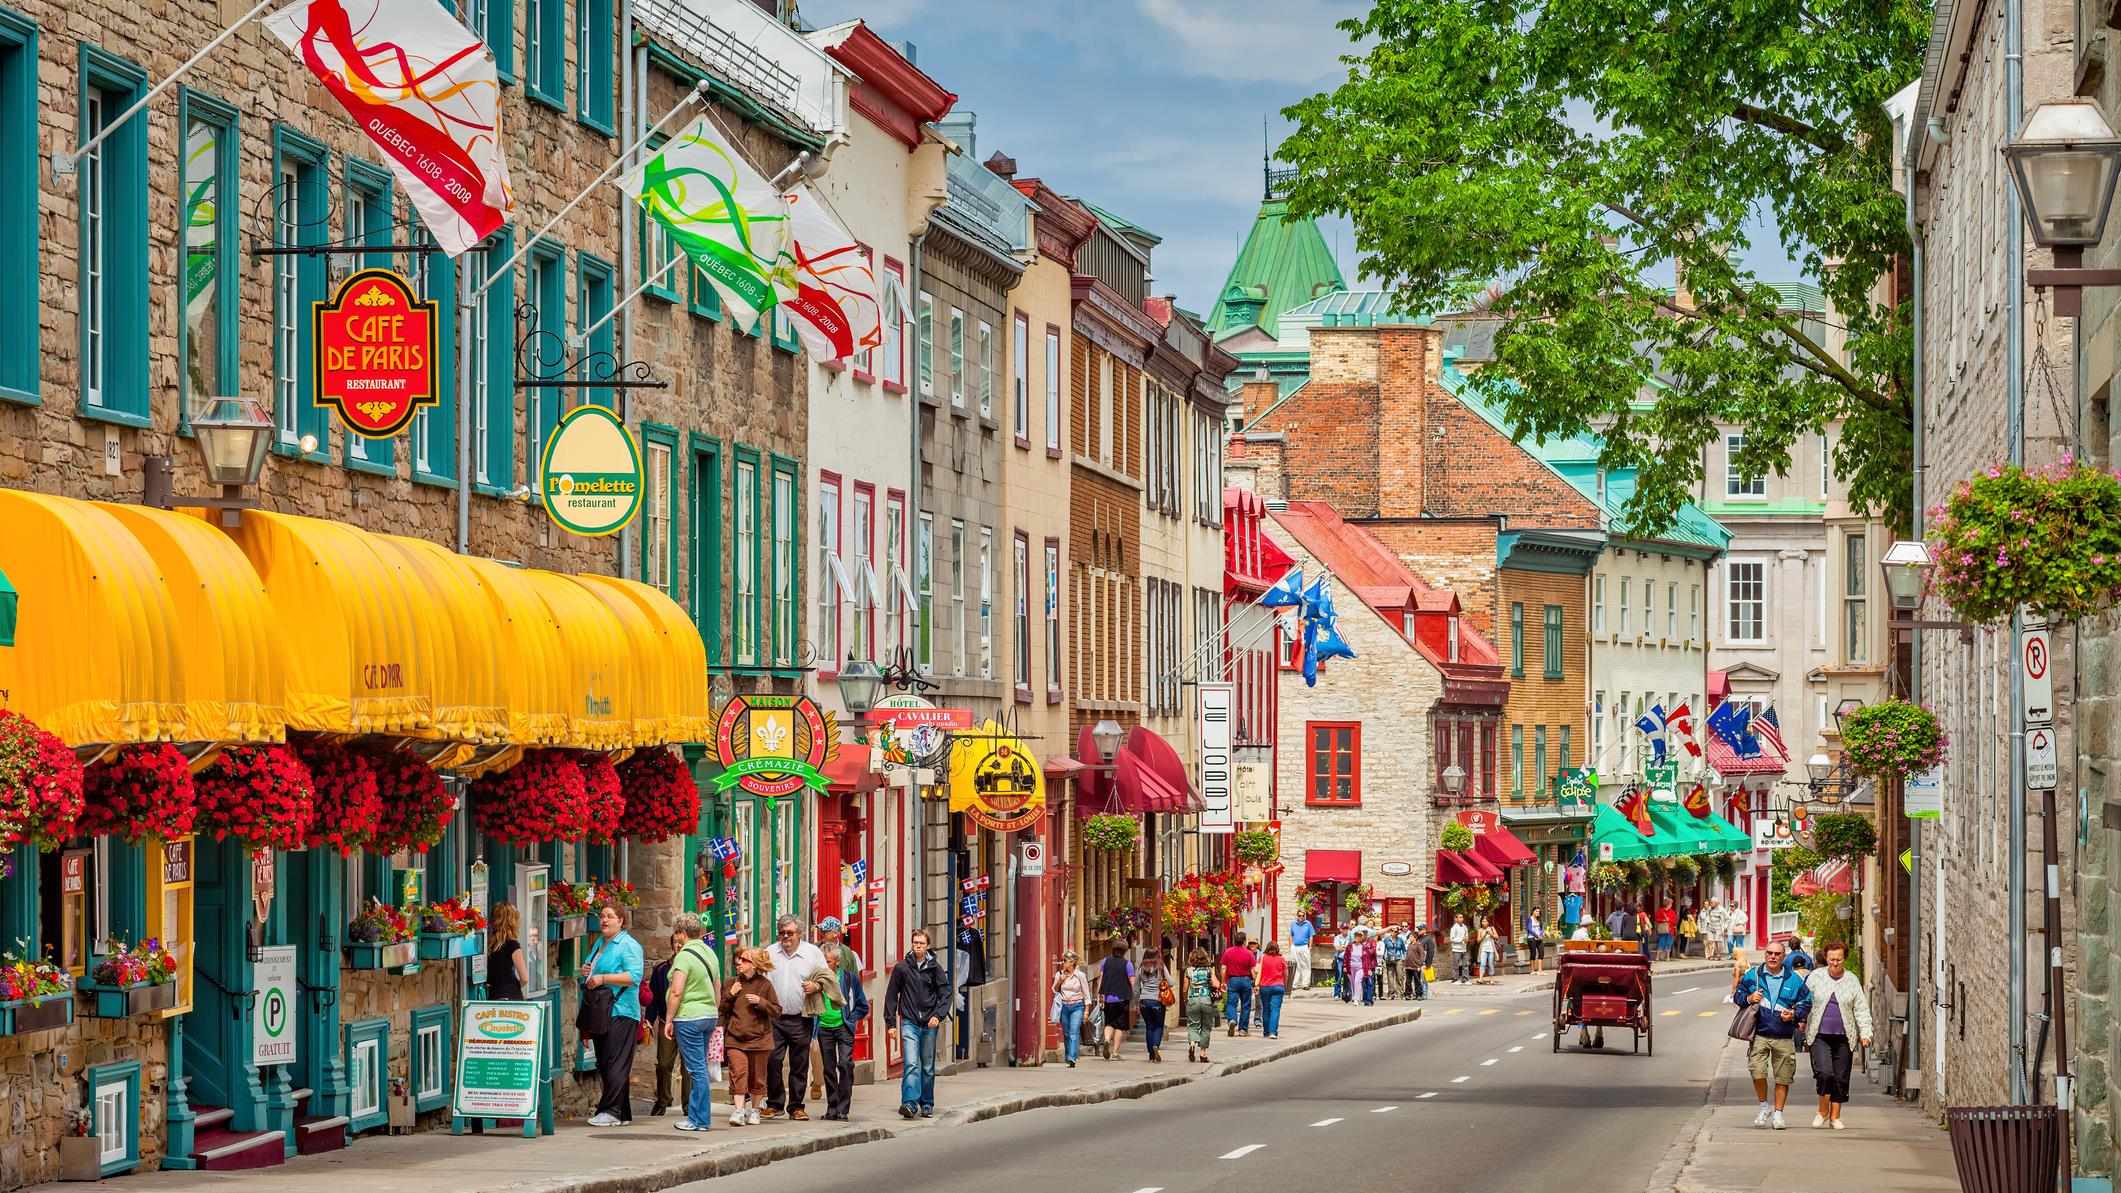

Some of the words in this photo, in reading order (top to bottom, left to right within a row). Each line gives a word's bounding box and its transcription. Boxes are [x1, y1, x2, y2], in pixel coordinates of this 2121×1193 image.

[368, 118, 417, 158] QUÉBEC
[700, 254, 736, 280] QUÉBEC
[345, 313, 405, 343] CAFÉ
[328, 345, 357, 371] DE
[361, 344, 424, 371] PARIS
[346, 379, 406, 390] RESTAURANT
[106, 442, 119, 460] 1827
[568, 498, 616, 508] restaurant
[751, 697, 792, 707] MAISON
[890, 698, 920, 708] HÔTEL
[898, 712, 951, 721] CAVALIER
[1204, 701, 1227, 722] LE
[936, 720, 958, 728] moulin
[737, 759, 804, 772] CRÉMAZIE
[1203, 739, 1228, 815] LOBBY
[747, 781, 795, 792] SOUVENIRS
[970, 807, 979, 817] LA
[980, 816, 1005, 829] PORTE
[165, 864, 171, 883] DE
[172, 862, 187, 882] PARIS
[270, 997, 281, 1027] P
[475, 1008, 497, 1021] CAFÉ
[498, 1009, 530, 1021] BISTRO
[258, 1042, 291, 1057] GRATUIT
